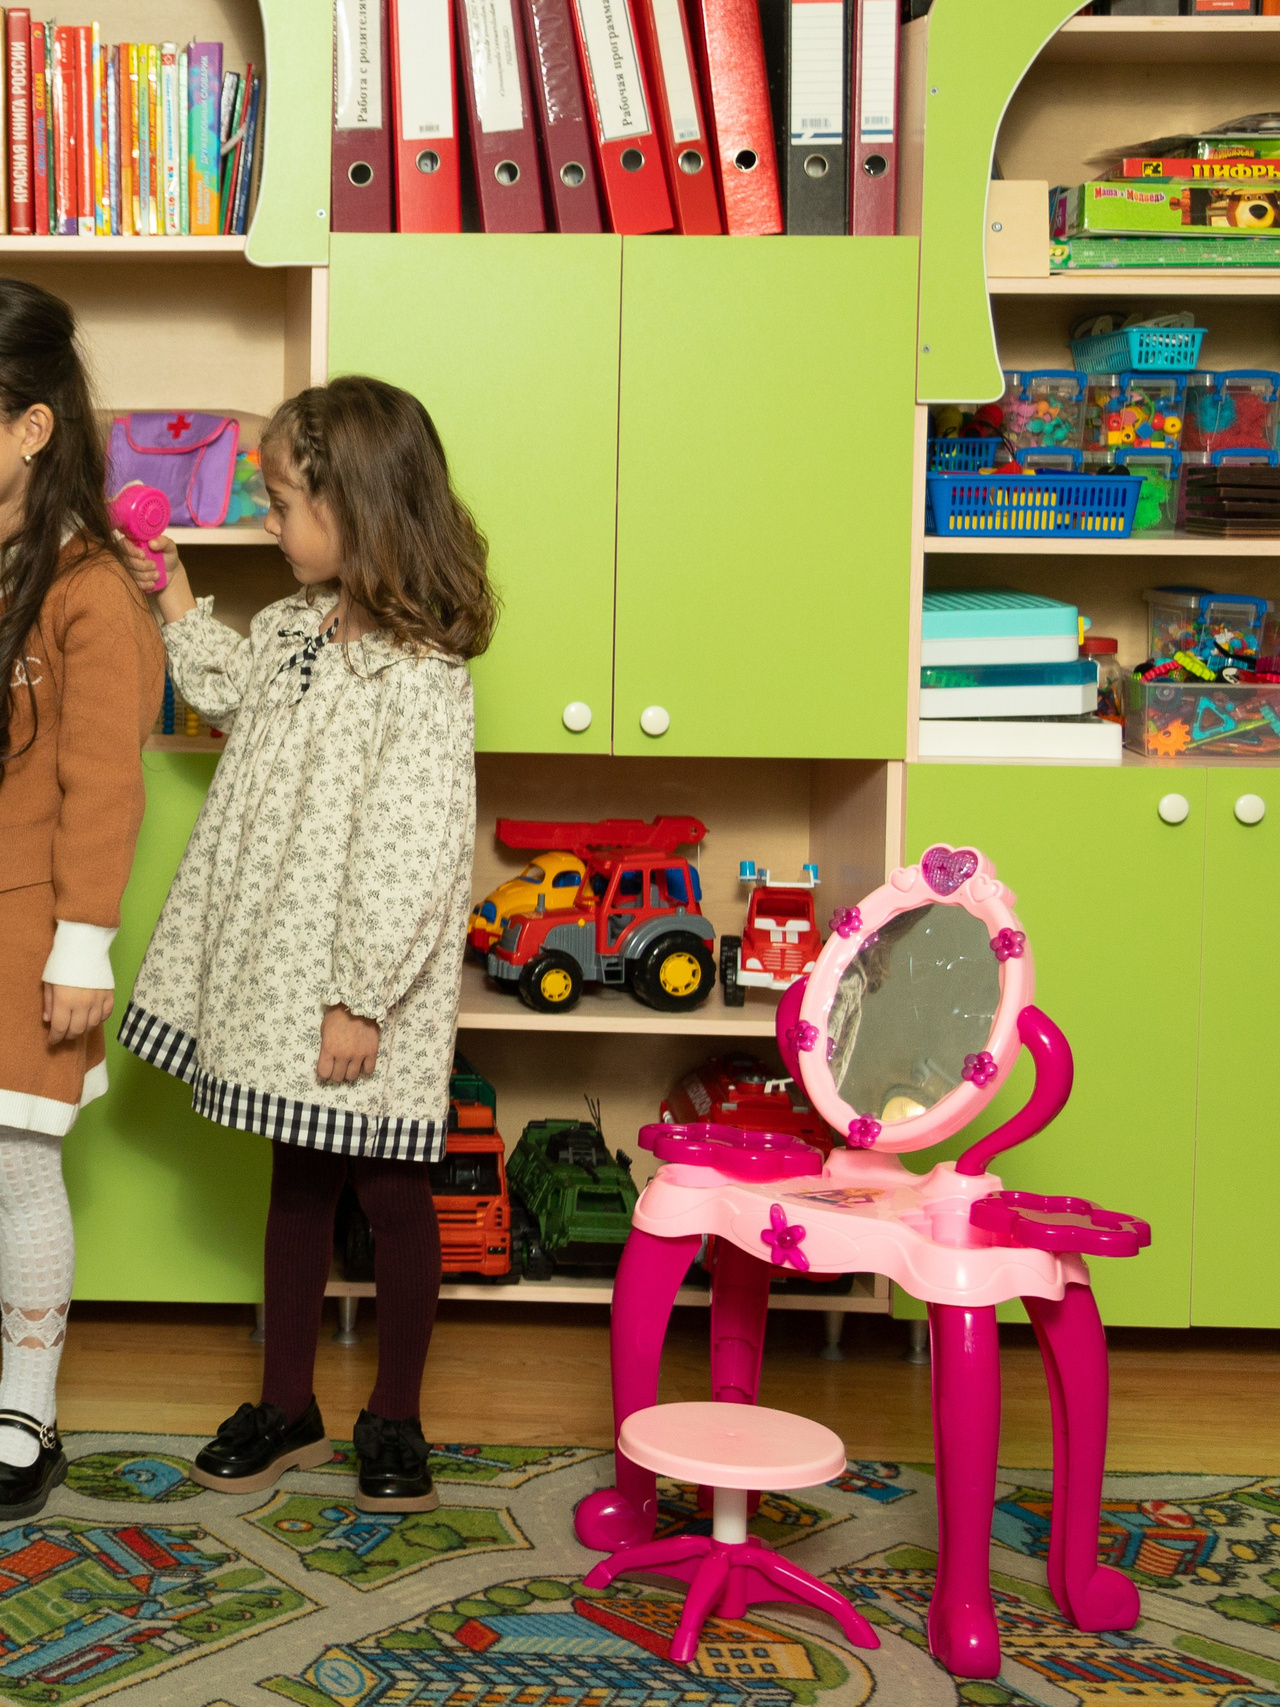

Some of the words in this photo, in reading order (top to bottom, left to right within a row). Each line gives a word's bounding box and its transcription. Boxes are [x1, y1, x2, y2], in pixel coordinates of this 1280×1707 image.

[358, 0, 370, 63] родителя
[11, 41, 26, 95] РОССИИ
[34, 73, 45, 110] СКАЗКИ
[12, 98, 27, 141] КНИГА
[357, 78, 368, 123] Работа
[615, 73, 633, 127] Рабочая
[13, 144, 29, 203] КРАСНАЯ
[1094, 186, 1118, 199] Маша
